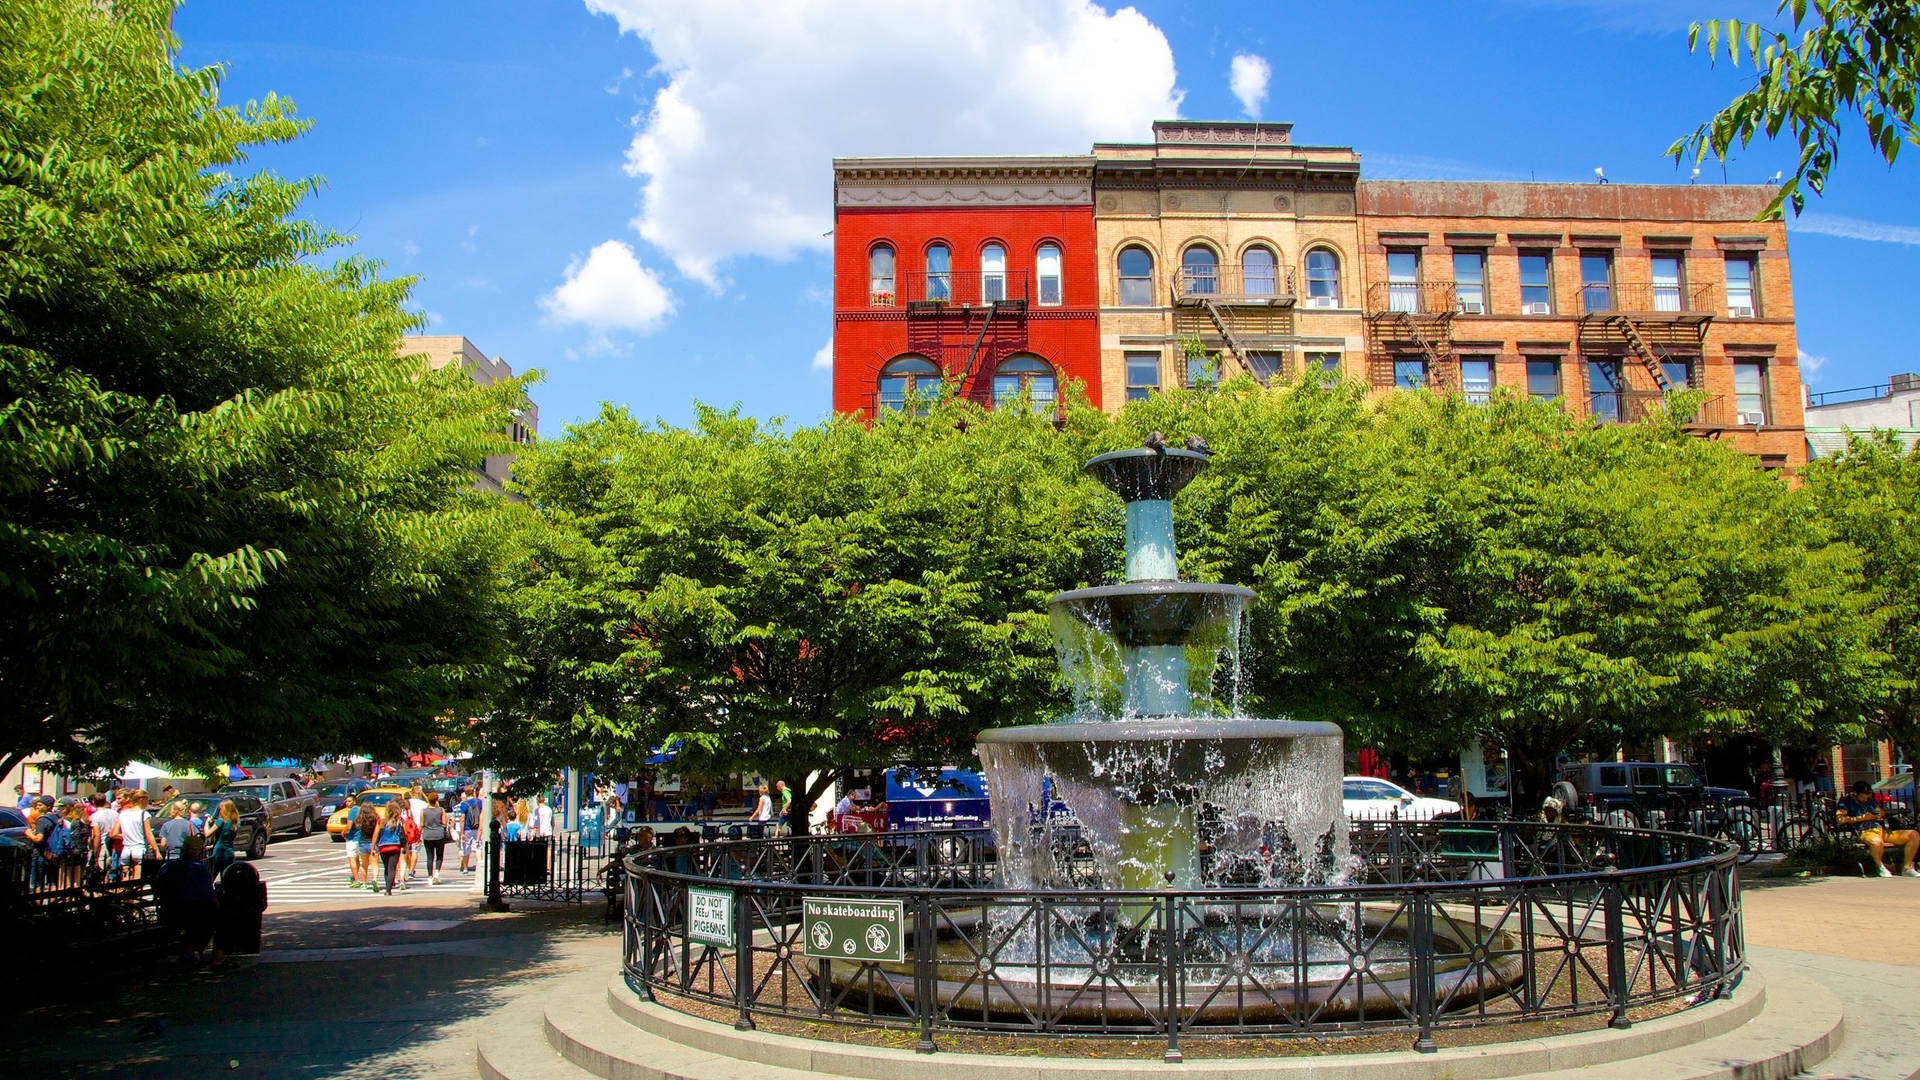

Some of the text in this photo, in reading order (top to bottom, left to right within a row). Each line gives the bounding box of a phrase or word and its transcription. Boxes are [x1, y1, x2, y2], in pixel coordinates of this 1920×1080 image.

[696, 896, 722, 909] DO NOT
[695, 907, 724, 920] FEED THE
[808, 903, 896, 921] No skateboarding
[693, 919, 726, 936] PIGEONS
